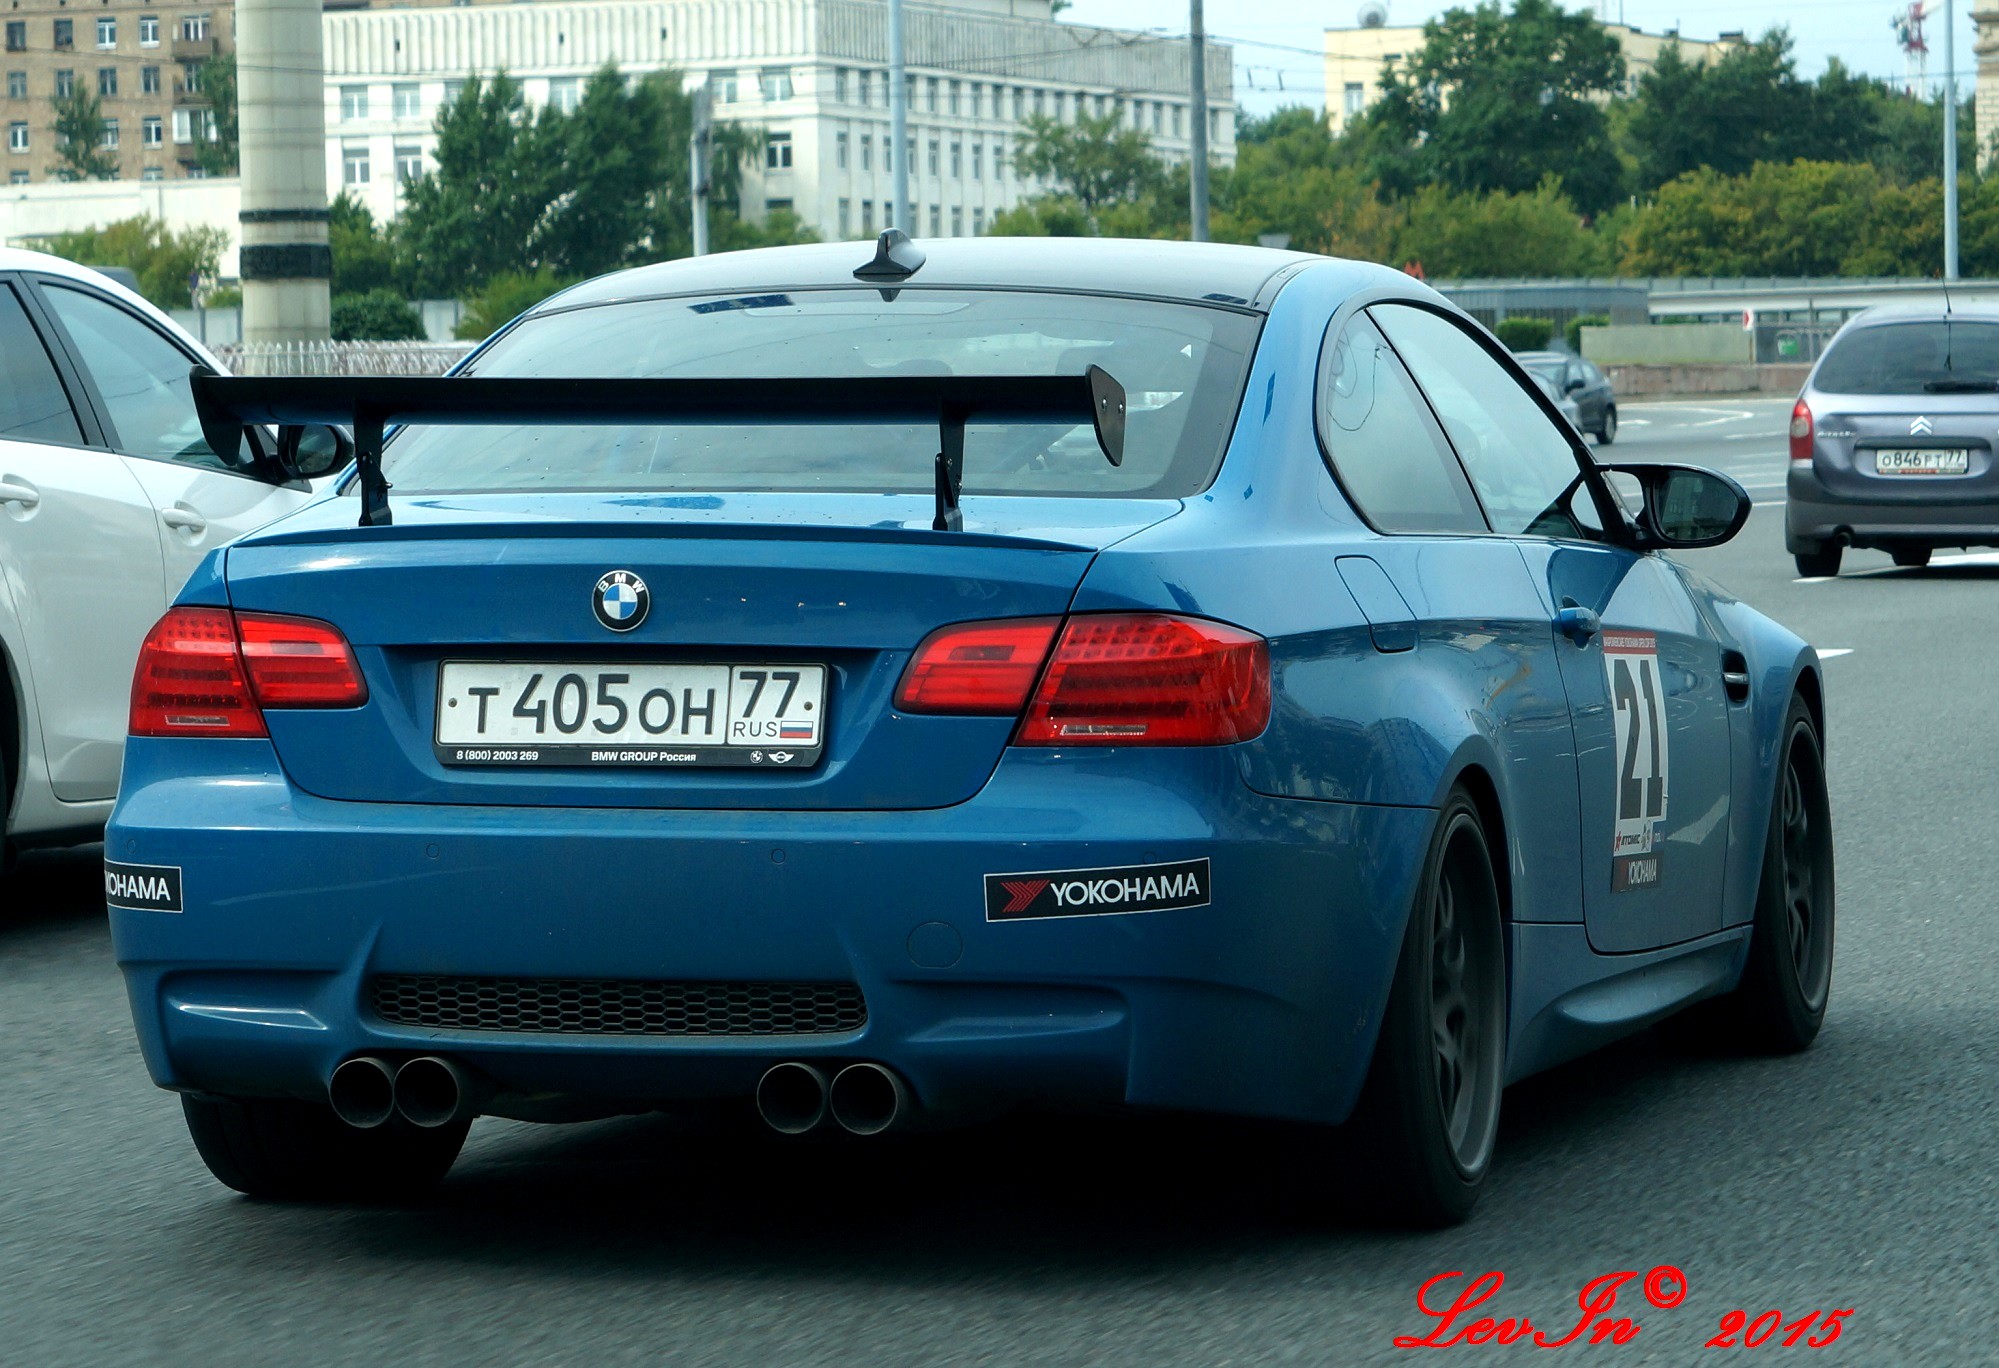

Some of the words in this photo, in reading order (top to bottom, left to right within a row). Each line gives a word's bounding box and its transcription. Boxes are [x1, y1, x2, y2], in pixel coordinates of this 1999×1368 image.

[598, 573, 645, 593] BMW
[739, 671, 800, 718] 77
[733, 721, 777, 738] RUS
[1613, 659, 1663, 819] 21
[456, 750, 463, 760] 8
[465, 750, 491, 760] (800)
[493, 751, 518, 760] 2003
[520, 751, 539, 760] 269
[591, 751, 618, 761] BMW
[620, 751, 658, 761] GROUP
[660, 752, 696, 762] Россия
[1628, 859, 1657, 885] YOKOHAMA
[1050, 872, 1200, 906] YOKOHAMA
